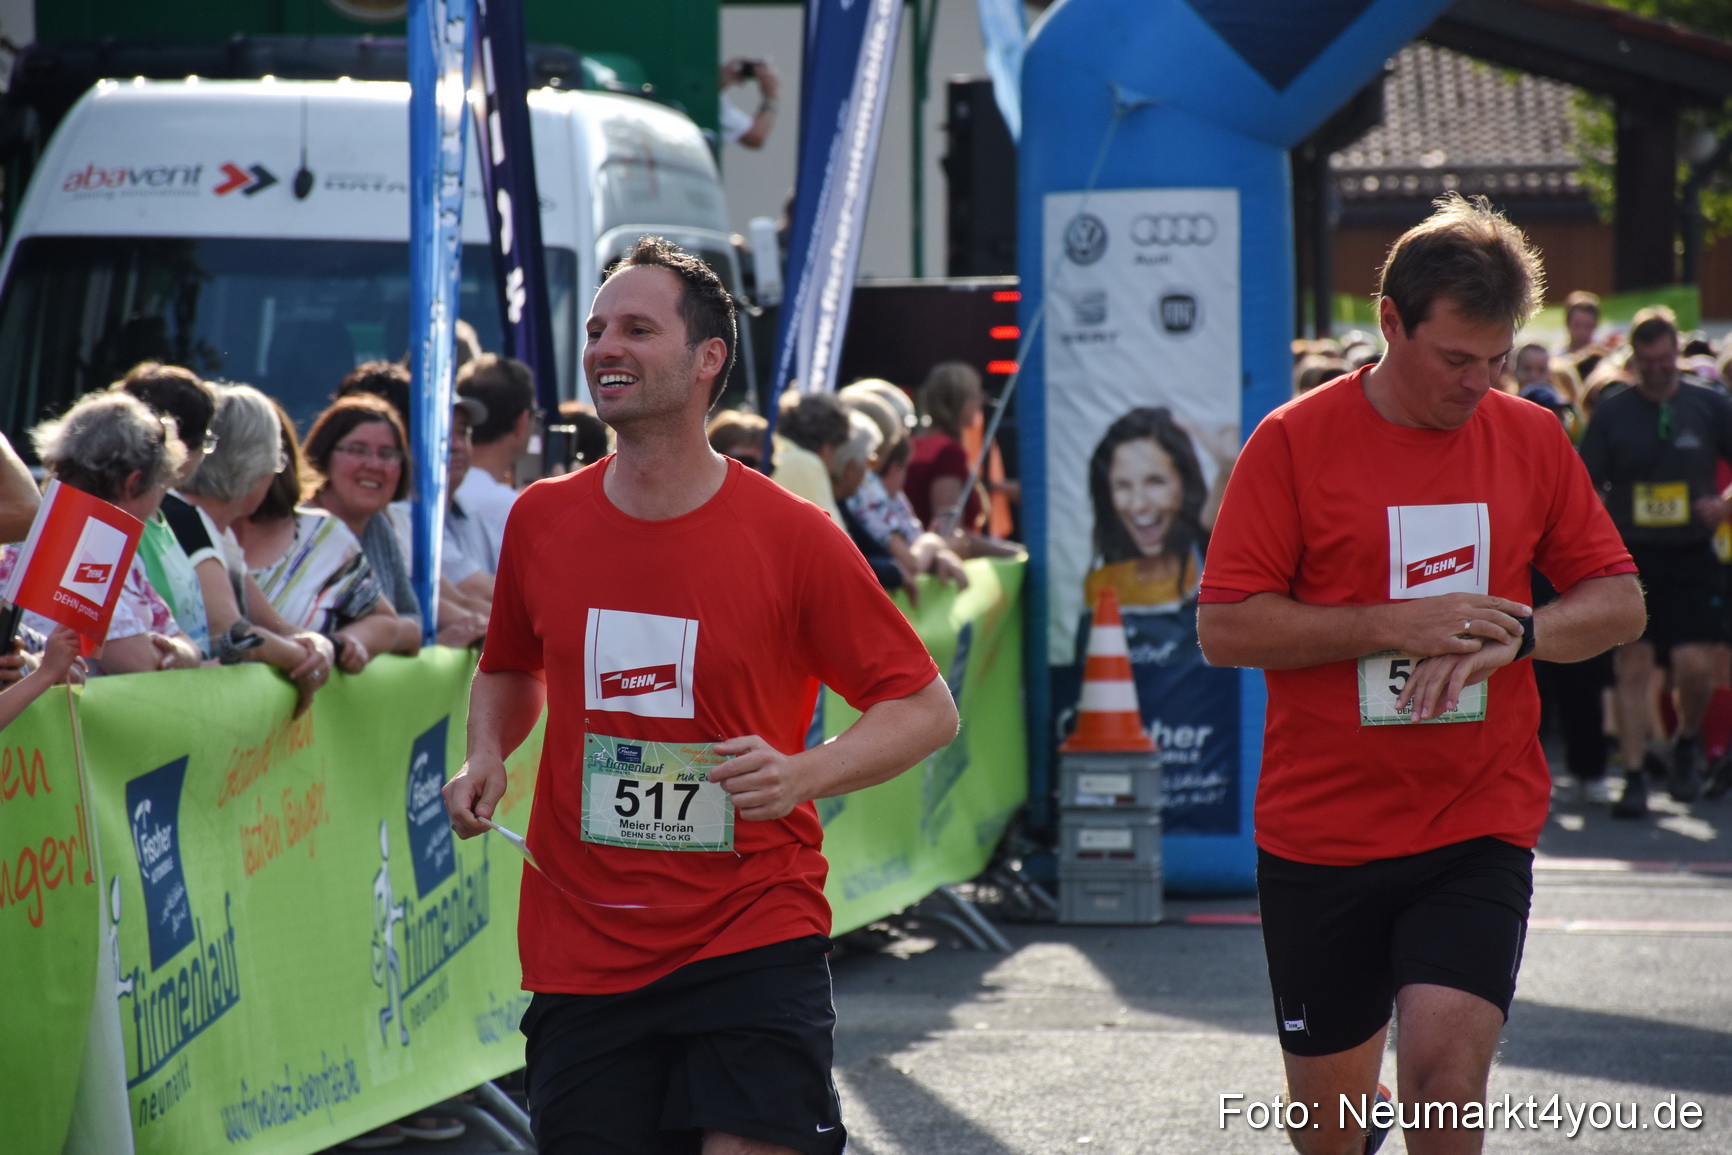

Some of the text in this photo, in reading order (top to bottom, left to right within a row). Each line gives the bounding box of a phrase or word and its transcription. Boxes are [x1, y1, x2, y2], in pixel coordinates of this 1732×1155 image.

[63, 162, 204, 191] abavent
[1424, 557, 1457, 576] DEHN
[53, 590, 80, 609] DEHN
[621, 673, 656, 689] DEHN
[606, 758, 664, 774] firmenlauf
[676, 772, 695, 782] run
[614, 778, 700, 821] 517
[619, 819, 694, 833] Meier Florian
[621, 831, 643, 839] DEHN
[646, 832, 656, 840] SE
[140, 822, 172, 868] Fischer
[133, 891, 240, 1077] firmenlauf
[138, 1052, 192, 1128] neumarkt
